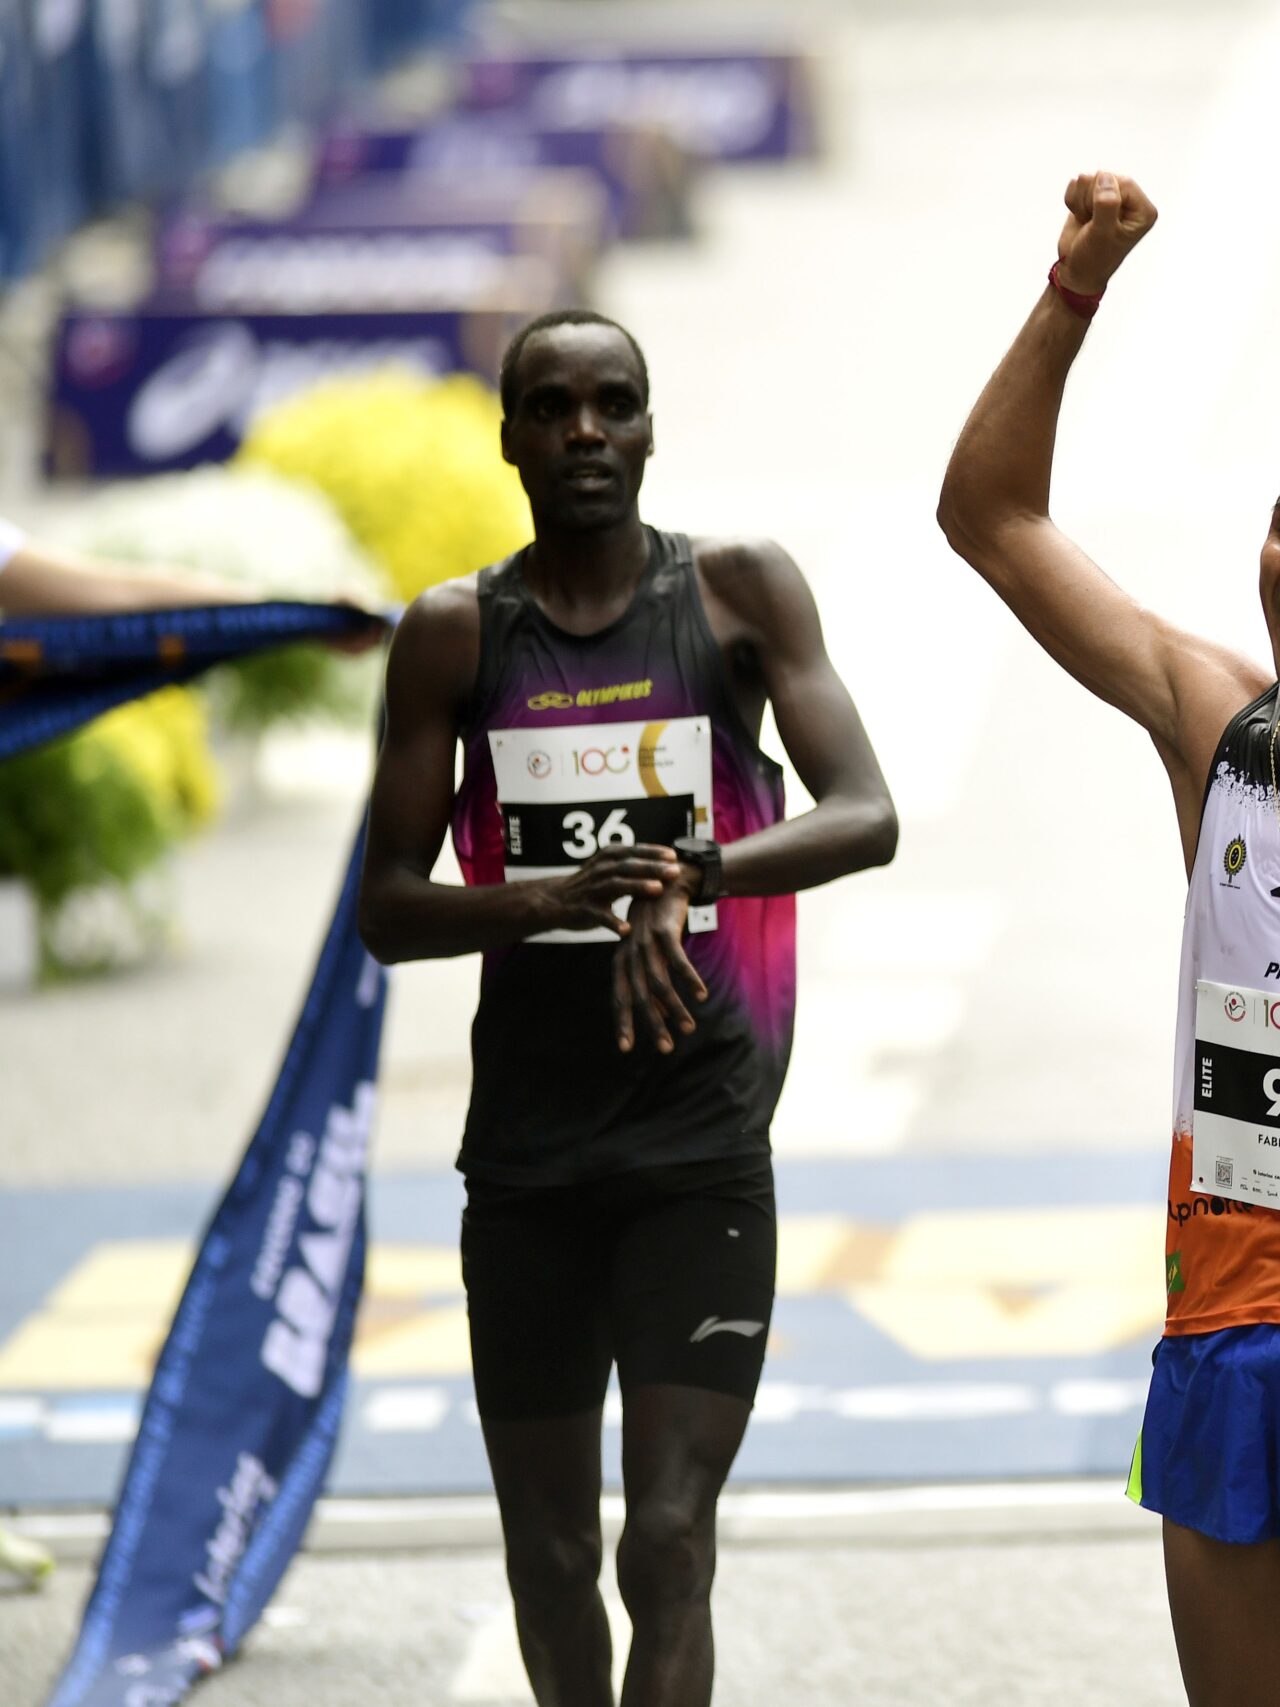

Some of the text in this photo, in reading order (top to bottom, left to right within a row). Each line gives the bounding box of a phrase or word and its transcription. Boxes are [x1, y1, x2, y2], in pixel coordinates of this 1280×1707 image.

[509, 816, 523, 855] ELITE
[562, 808, 635, 859] 36
[1201, 1057, 1213, 1098] ELITE
